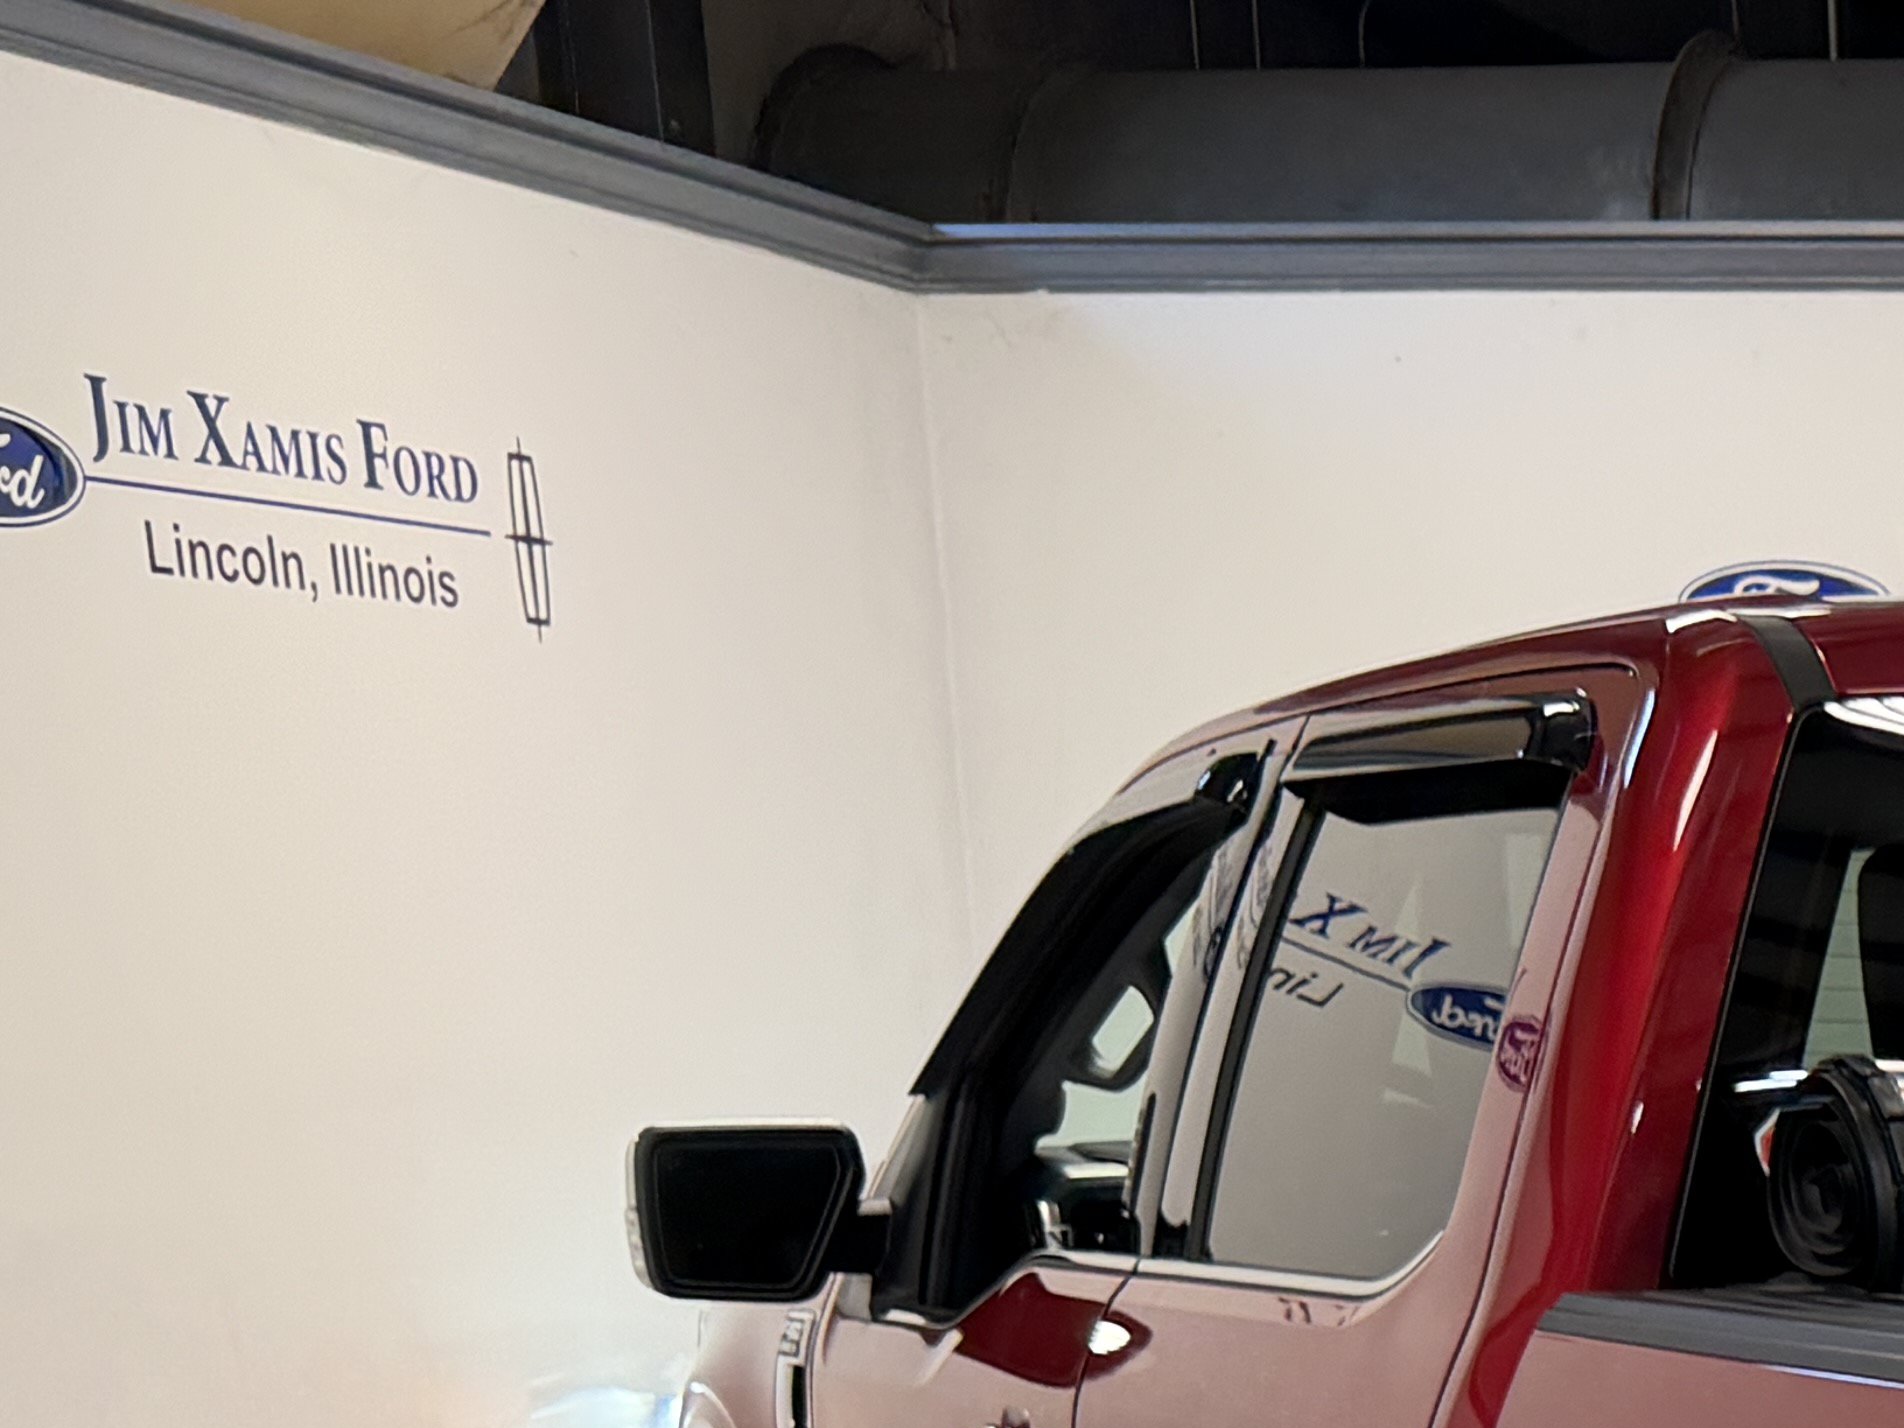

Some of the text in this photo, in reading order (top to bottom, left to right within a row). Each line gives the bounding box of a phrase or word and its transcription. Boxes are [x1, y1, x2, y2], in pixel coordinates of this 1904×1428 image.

[187, 390, 347, 486] XAMIS
[356, 419, 479, 503] FORD
[143, 519, 459, 608] Lincoln, Illinois
